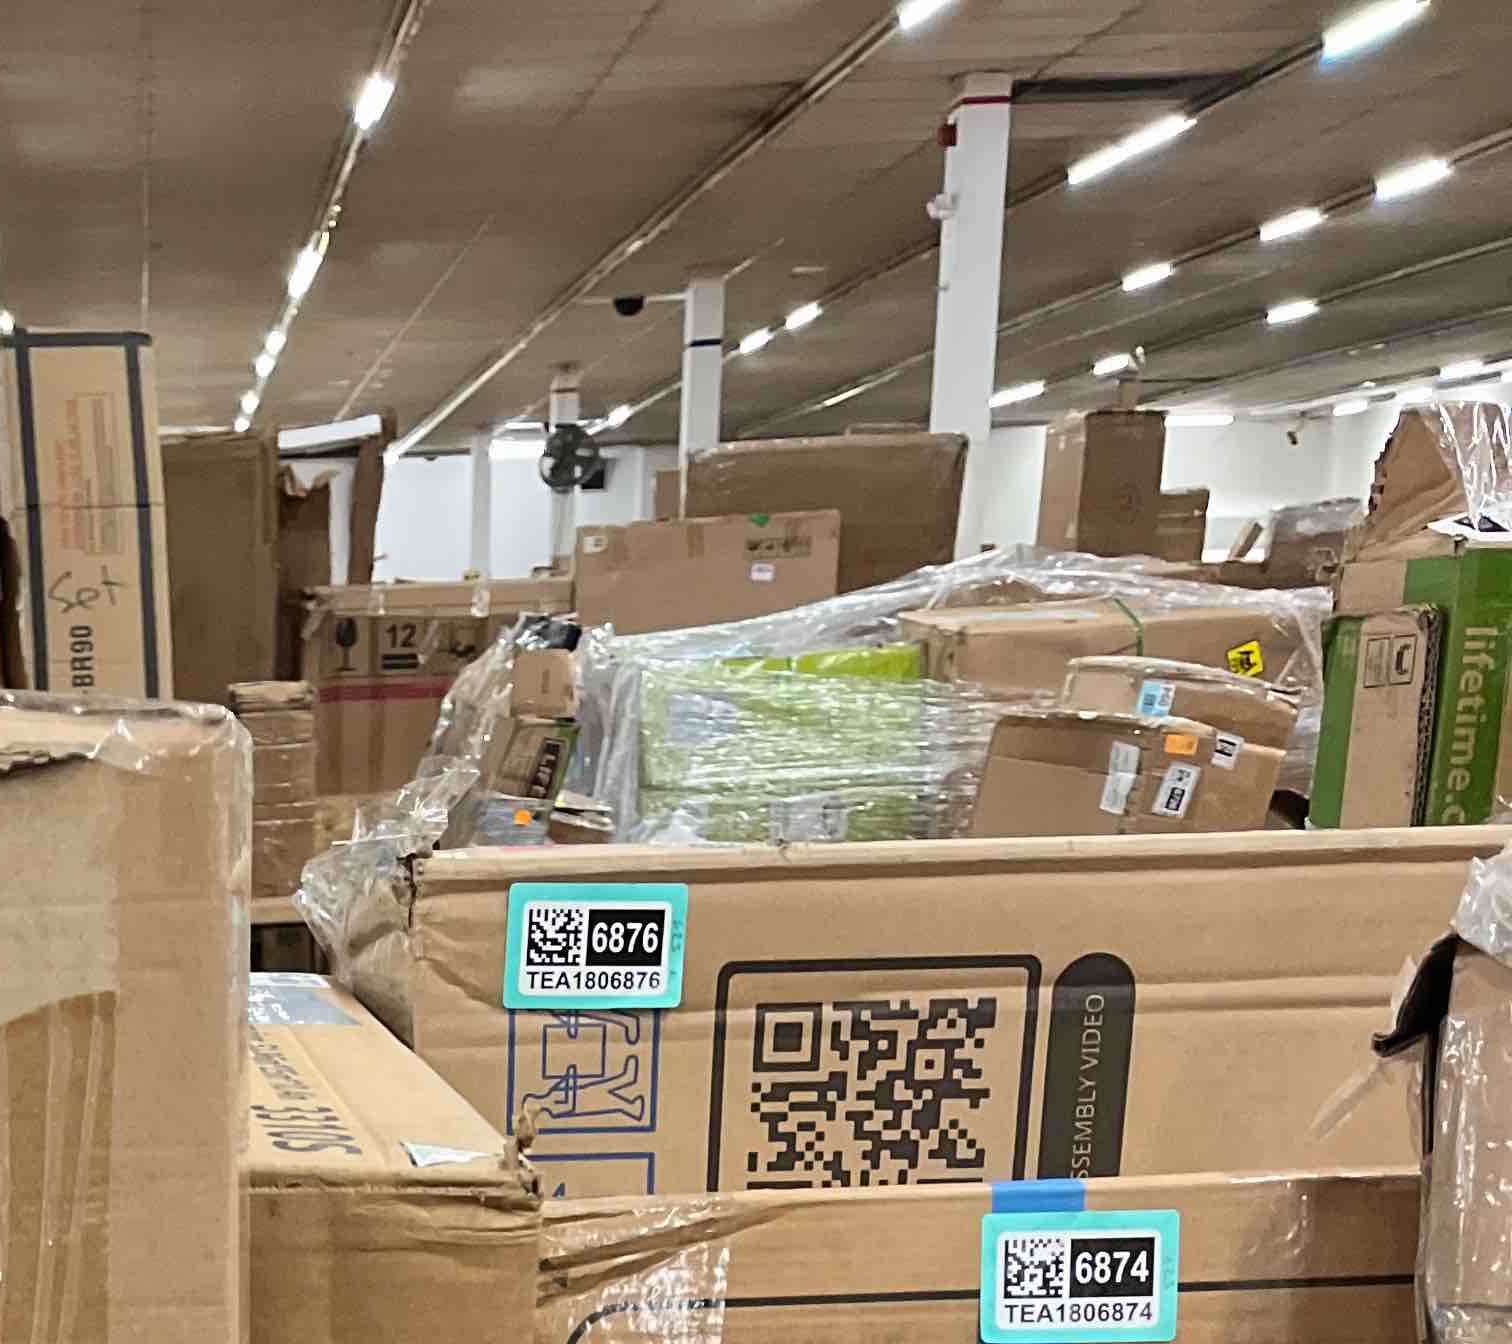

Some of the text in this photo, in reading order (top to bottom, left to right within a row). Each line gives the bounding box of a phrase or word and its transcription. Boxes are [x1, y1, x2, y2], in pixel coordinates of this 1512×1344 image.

[385, 623, 417, 648] 12
[591, 921, 659, 954] 6876
[525, 970, 661, 991] TEA1806876
[1070, 993, 1105, 1178] SSEMBLY VIDEO
[1074, 1250, 1150, 1285] 6874
[1004, 1303, 1153, 1323] TEA1806874
